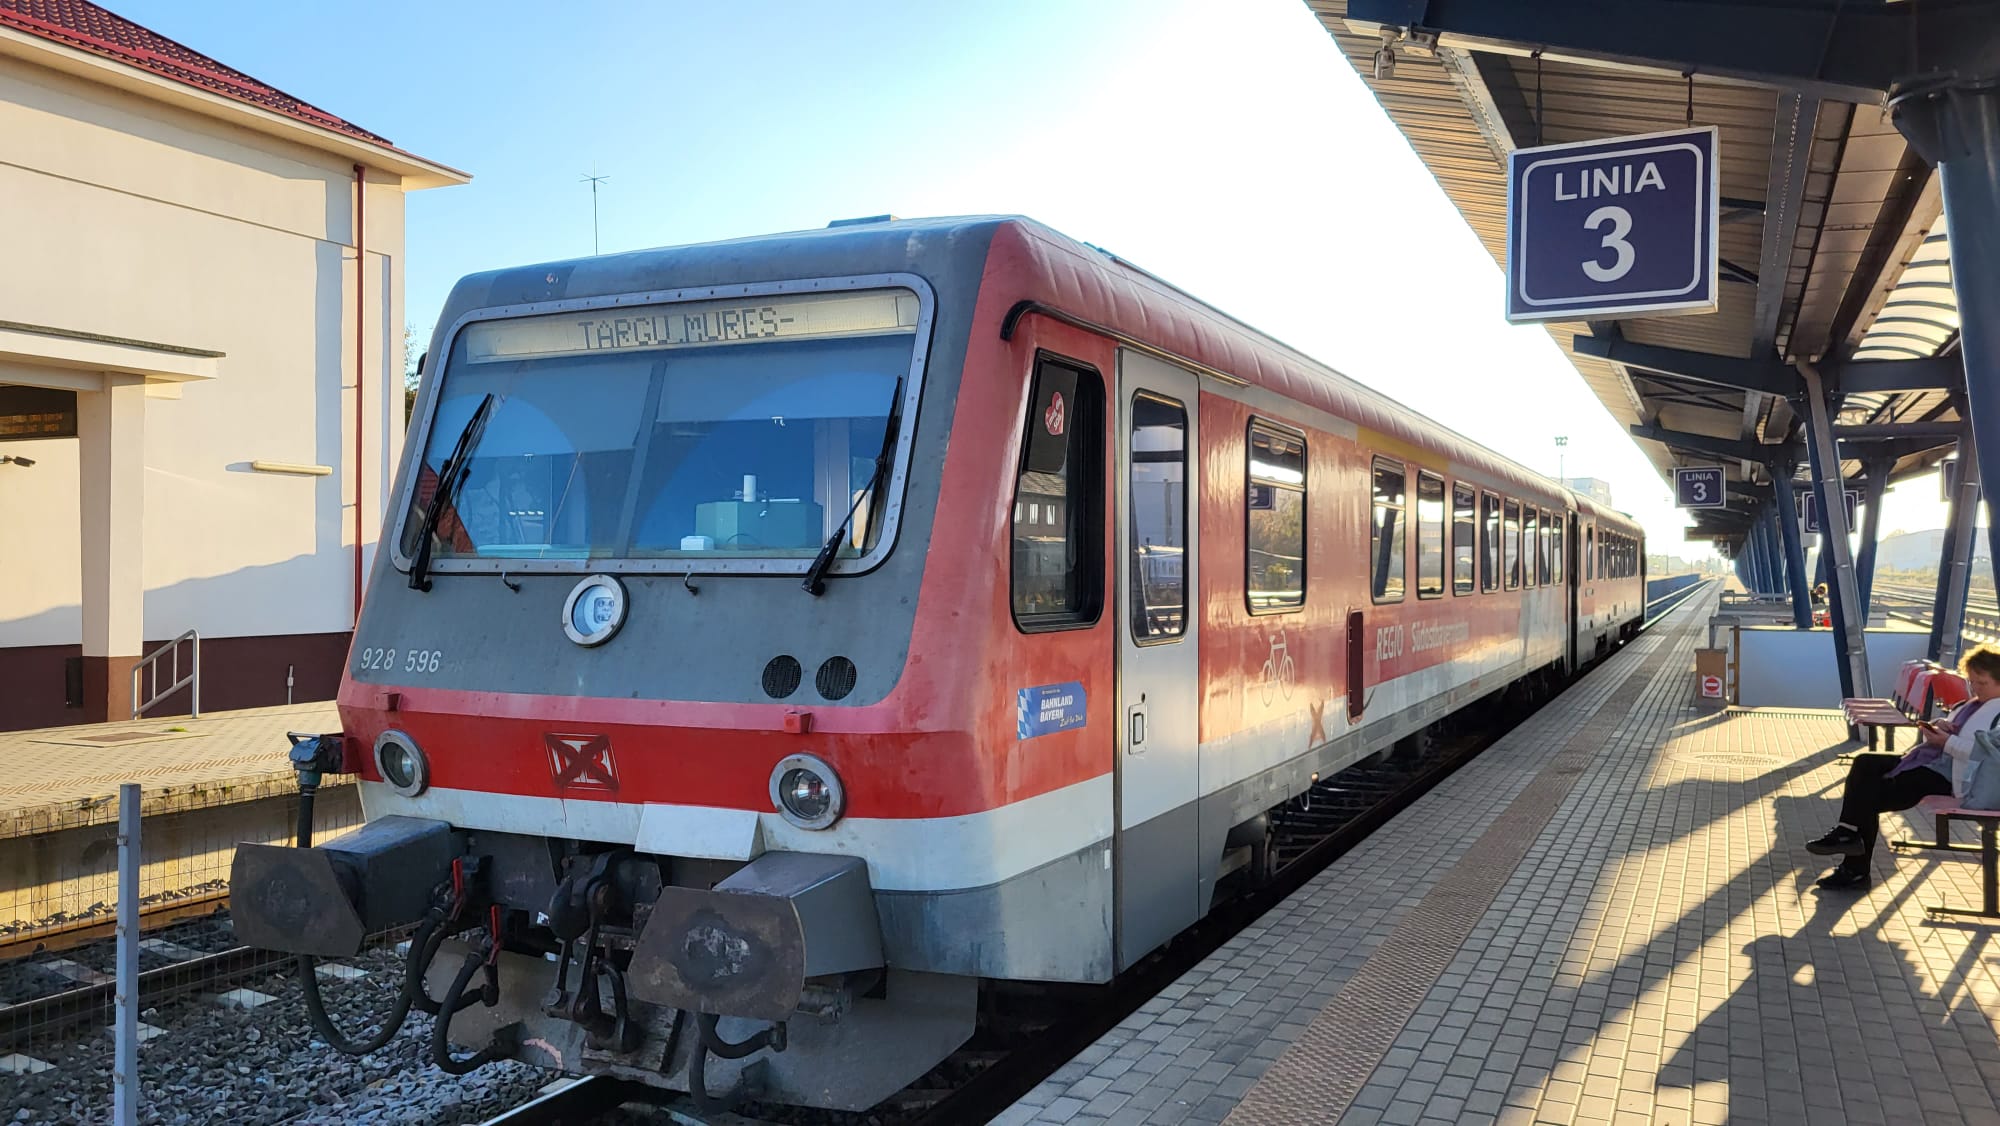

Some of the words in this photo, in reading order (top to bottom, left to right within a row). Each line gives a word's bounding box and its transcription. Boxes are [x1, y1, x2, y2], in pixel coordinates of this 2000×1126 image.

[1555, 162, 1666, 201] LINIA
[1581, 205, 1636, 283] 3
[1685, 472, 1714, 482] LINIA
[1692, 482, 1707, 502] 3
[1376, 624, 1404, 662] REGIO
[360, 647, 396, 670] 928
[404, 649, 442, 673] 596
[1041, 695, 1074, 710] BAHNLAND
